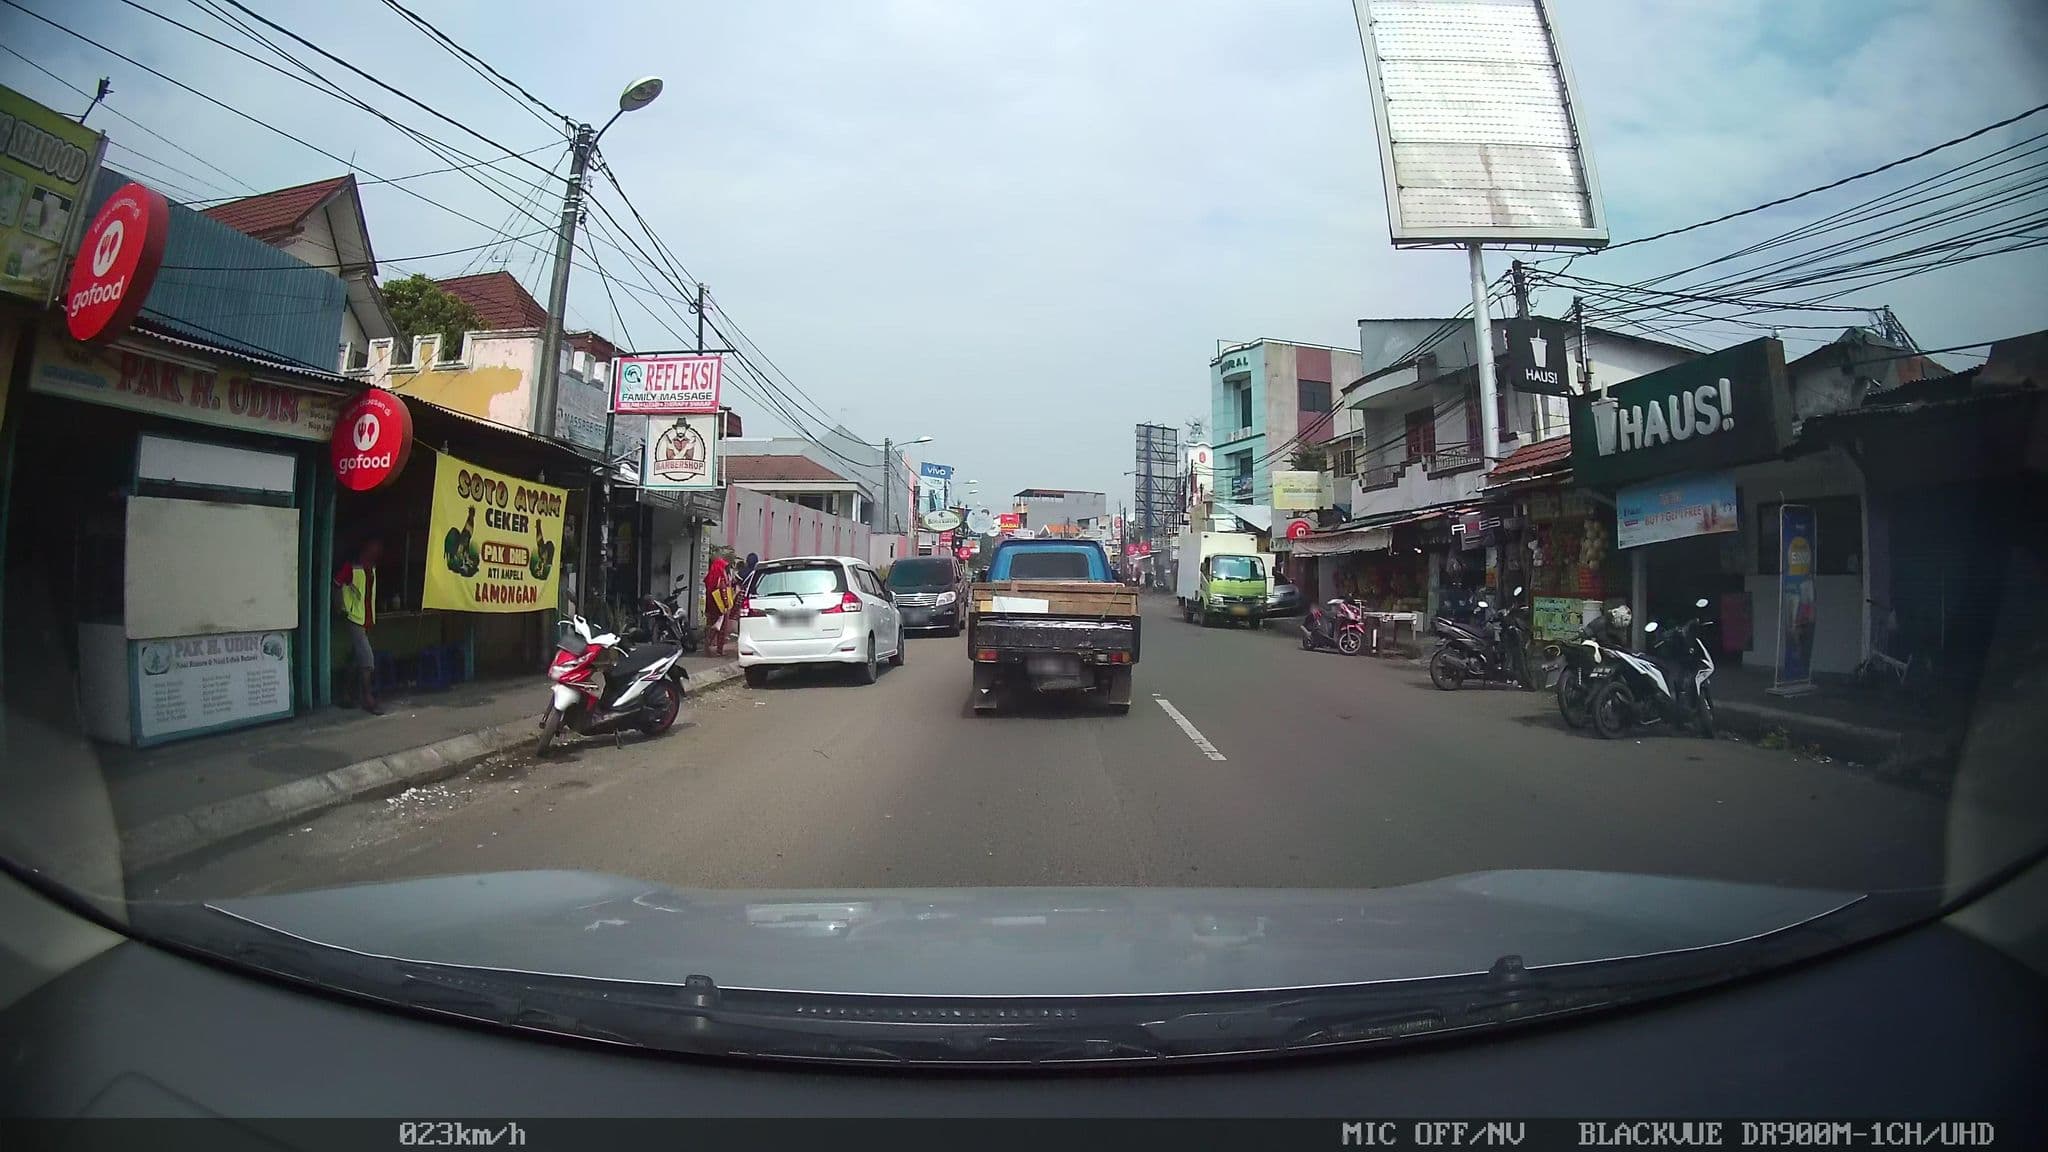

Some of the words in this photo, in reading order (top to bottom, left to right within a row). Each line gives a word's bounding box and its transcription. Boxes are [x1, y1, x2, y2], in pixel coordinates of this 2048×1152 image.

[71, 275, 125, 317] gofood
[645, 362, 714, 391] REFLEKSI
[1525, 368, 1558, 385] HAUS!
[115, 354, 184, 404] PAK
[227, 376, 301, 424] UDIN
[622, 392, 657, 402] FAMILY
[660, 391, 713, 401] MASSAGE
[1618, 377, 1735, 452] HAUS!
[339, 452, 391, 475] gofood
[656, 461, 704, 472] BARBERSHOP
[927, 466, 946, 476] vivo
[457, 469, 509, 509] SOTO
[514, 485, 562, 518] AYAM
[485, 508, 529, 533] CEKER
[484, 544, 504, 563] PAK
[488, 568, 499, 579] ATI
[475, 582, 537, 605] LAMONGAN
